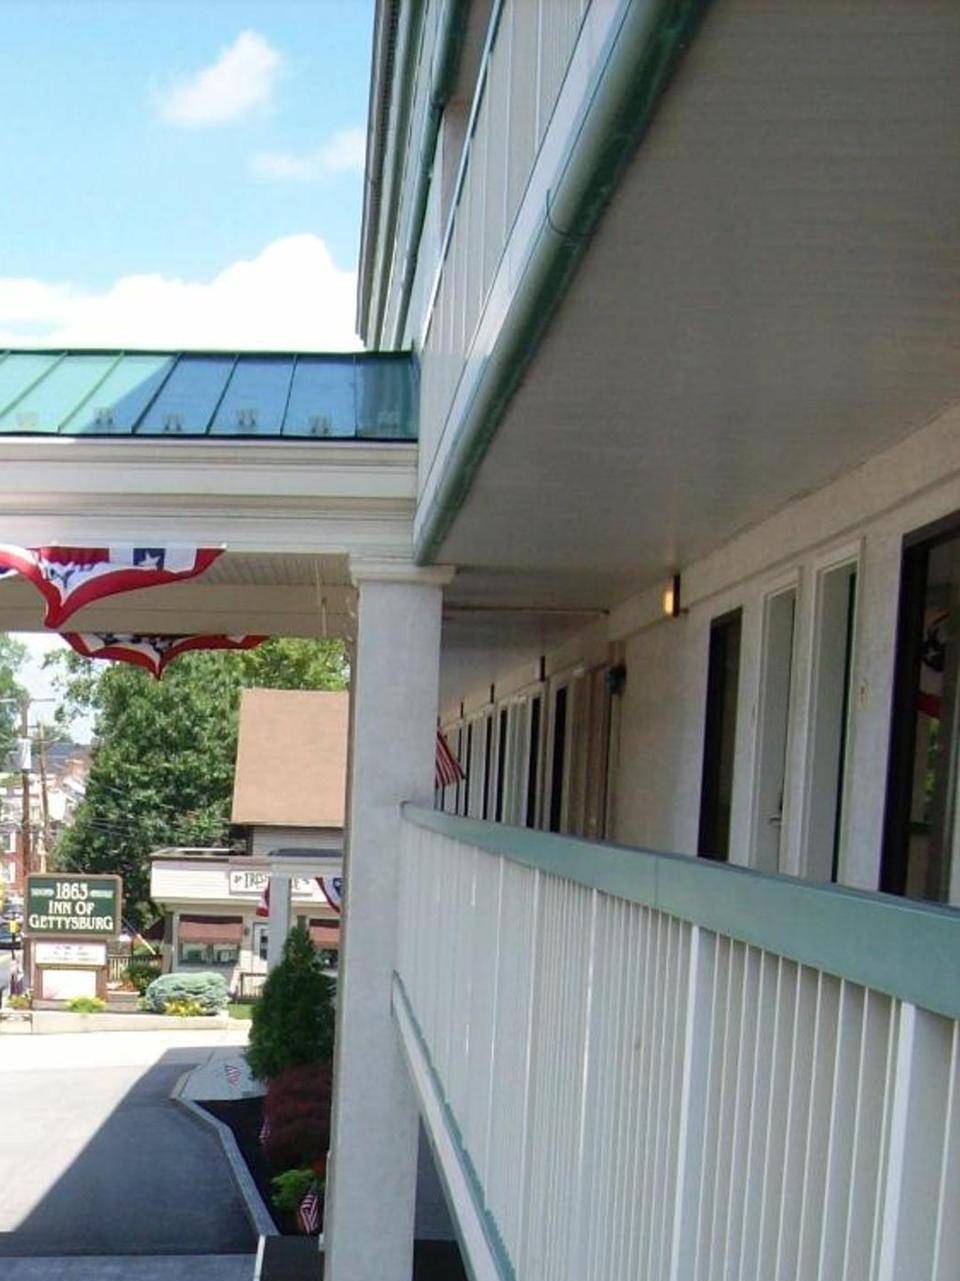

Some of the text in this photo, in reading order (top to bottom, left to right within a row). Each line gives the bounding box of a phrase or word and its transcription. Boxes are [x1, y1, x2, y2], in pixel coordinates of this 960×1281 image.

[55, 882, 88, 900] 1863
[48, 900, 95, 915] INN OF
[28, 914, 114, 930] GETTYSBURG
